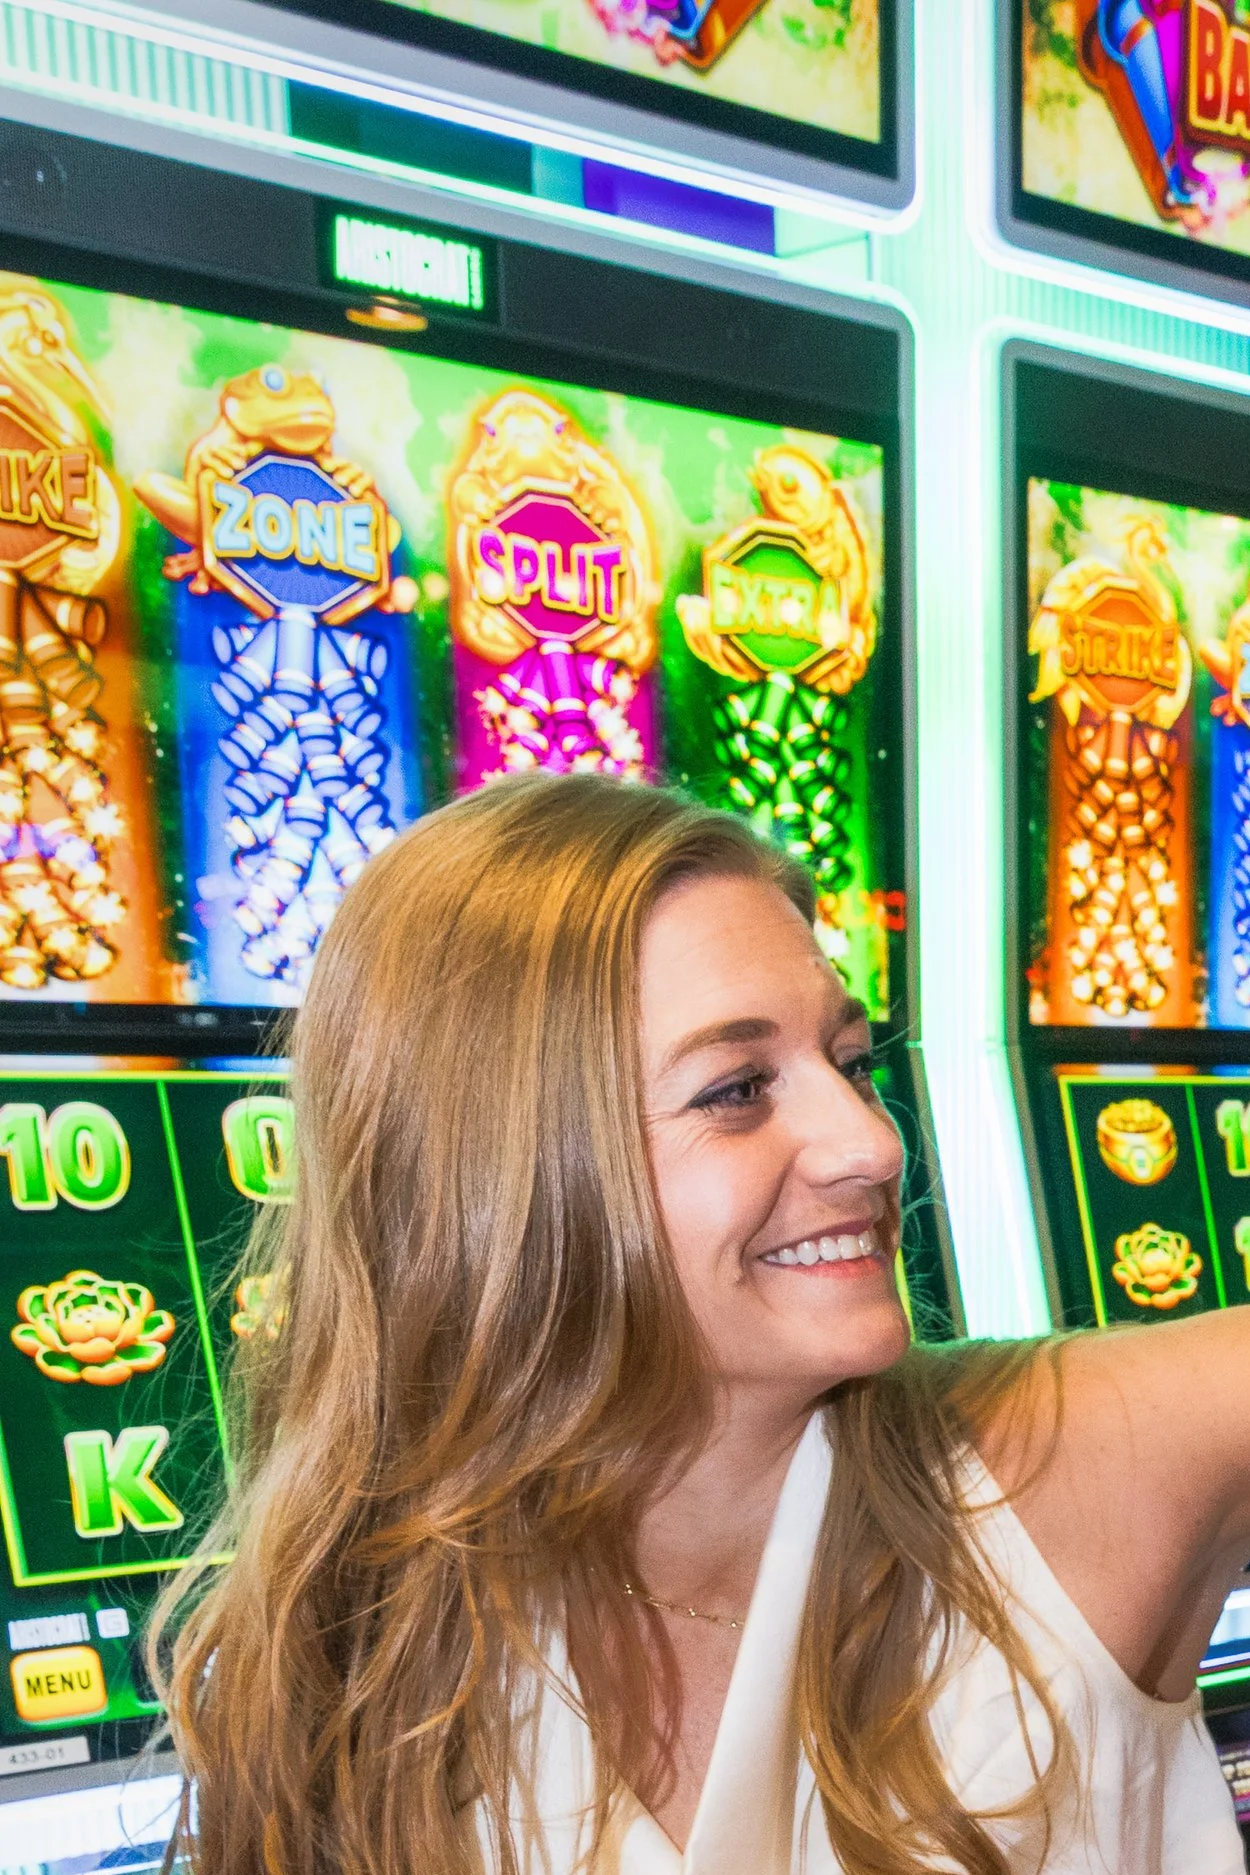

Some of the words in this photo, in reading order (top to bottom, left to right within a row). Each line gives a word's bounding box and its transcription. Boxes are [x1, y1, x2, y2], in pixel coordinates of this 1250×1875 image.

[212, 478, 382, 582] ZONE
[474, 525, 627, 623] SPLIT
[709, 560, 842, 646] EXTRA
[1061, 612, 1179, 689] STRIKE
[0, 1101, 131, 1211] 10
[64, 1425, 184, 1538] K
[26, 1669, 92, 1697] MENU
